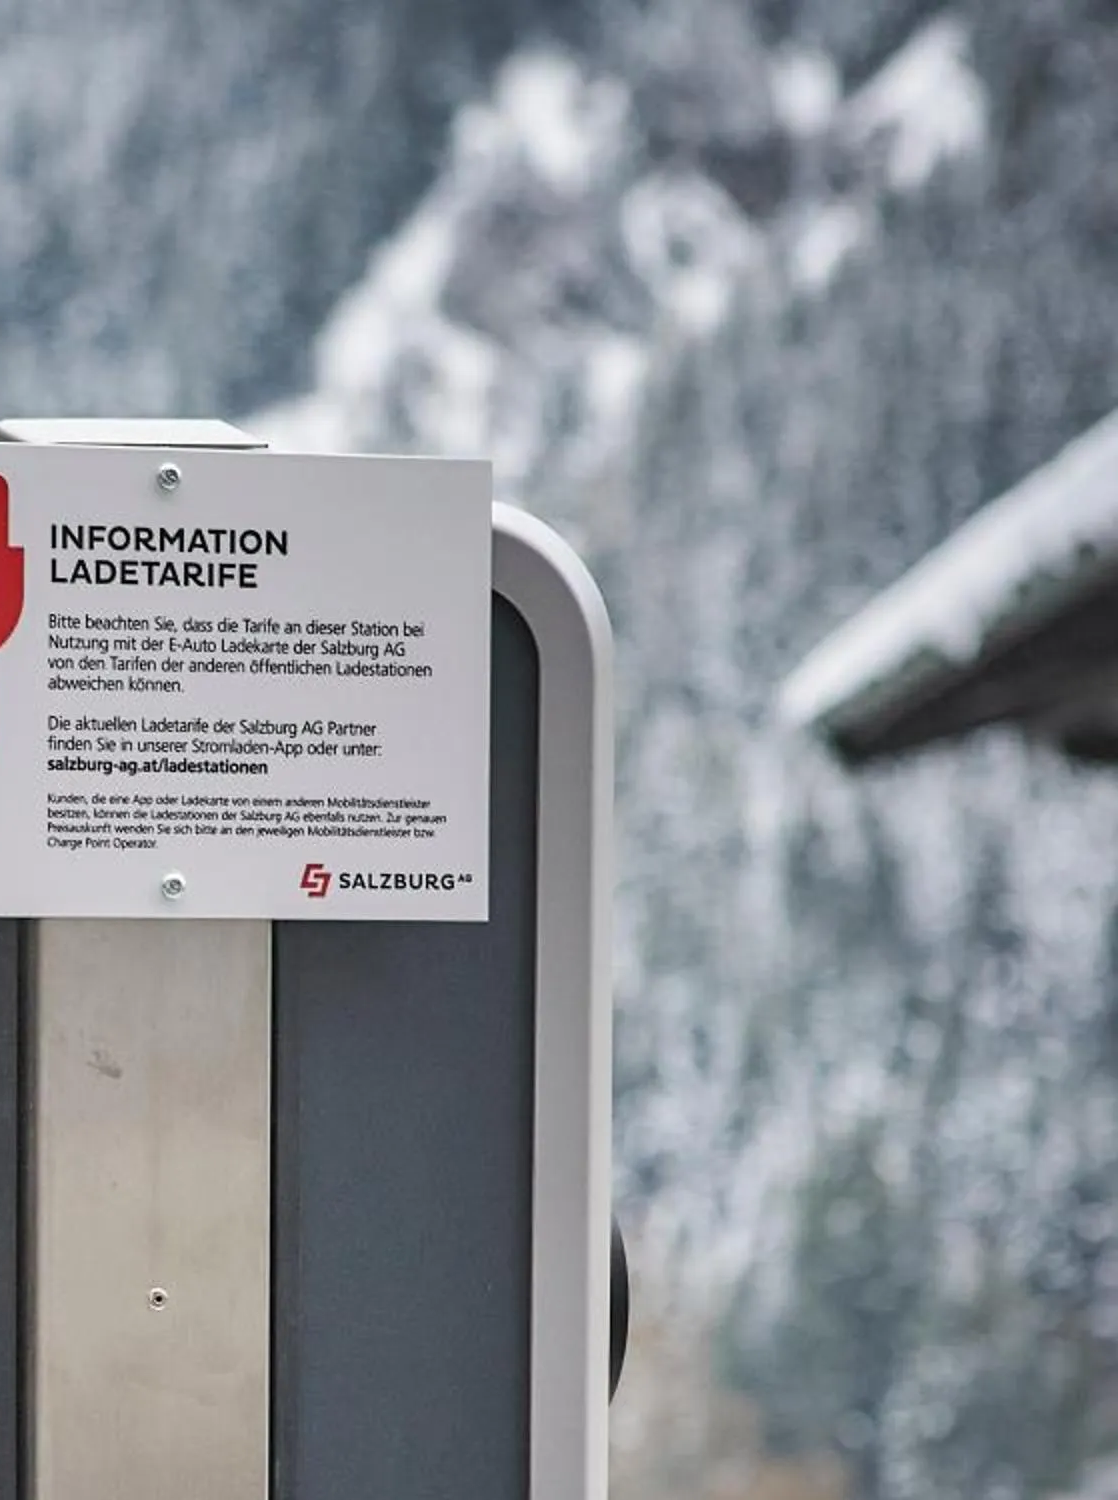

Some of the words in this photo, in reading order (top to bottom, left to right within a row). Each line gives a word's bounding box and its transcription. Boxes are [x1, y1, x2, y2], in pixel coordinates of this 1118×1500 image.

[50, 524, 288, 556] INFORMATION
[50, 558, 258, 588] LADETARIFE
[48, 614, 81, 629] Bitte
[85, 614, 149, 631] beachten
[154, 616, 178, 633] Sie,
[182, 617, 213, 632] dass
[217, 617, 238, 632] die
[243, 617, 280, 633] Tarife
[284, 621, 301, 634] an
[306, 619, 346, 635] dieser
[351, 621, 399, 636] Station
[403, 621, 424, 637] bei
[48, 635, 109, 654] Nutzung
[114, 637, 137, 650] mit
[141, 637, 164, 651] der
[169, 637, 216, 653] E-Auto
[221, 638, 289, 654] Ladekarte
[293, 640, 316, 655] der
[321, 640, 379, 660] Salzburg
[383, 642, 406, 657] AG
[47, 657, 74, 669] von
[78, 656, 105, 670] den
[110, 656, 157, 672] Tarifen
[161, 658, 184, 672] der
[189, 658, 245, 673] anderen
[249, 659, 332, 675] öffentlichen
[336, 660, 432, 677] Ladestationen
[47, 675, 124, 691] abweichen
[128, 676, 184, 693] können.
[47, 715, 71, 731] Die
[75, 716, 137, 732] aktuellen
[141, 717, 209, 733] Ladetarife
[213, 718, 236, 734] der
[239, 719, 297, 738] Salzburg
[301, 721, 323, 735] AG
[328, 721, 376, 736] Partner
[47, 736, 92, 751] finden
[97, 737, 117, 752] Sie
[121, 737, 133, 751] in
[137, 741, 188, 753] unserer
[191, 738, 303, 758] Stromladen-App
[307, 741, 338, 756] oder
[343, 743, 382, 757] unter:
[47, 756, 268, 776] salzburg-ag.at/ladestationen
[339, 872, 455, 890] SALZBURG
[458, 873, 473, 883] AG
